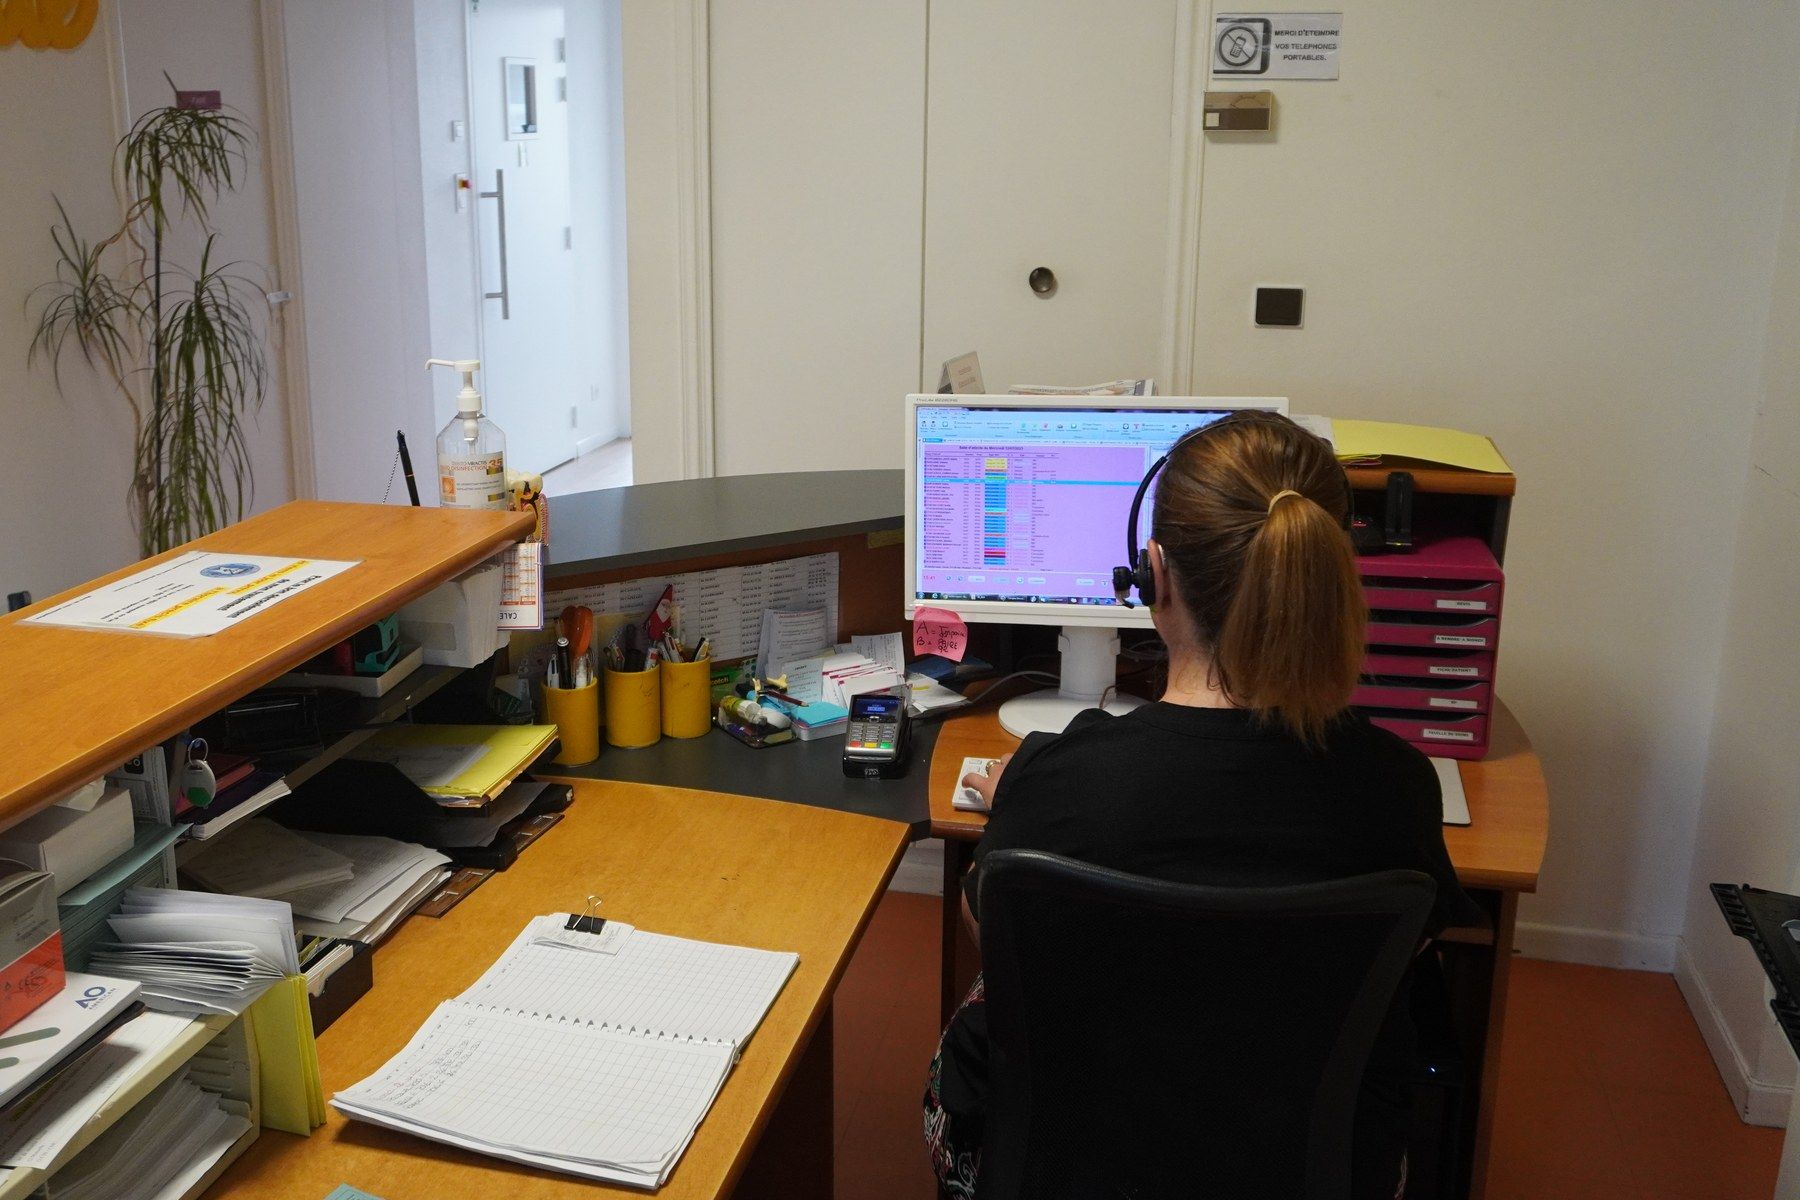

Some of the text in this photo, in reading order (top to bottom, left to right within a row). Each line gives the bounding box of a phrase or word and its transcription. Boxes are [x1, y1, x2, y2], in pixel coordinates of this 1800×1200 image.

[1274, 29, 1297, 37] MERCI
[916, 620, 928, 635] A
[917, 636, 925, 646] B
[711, 676, 729, 685] cotch
[75, 986, 107, 1009] AO
